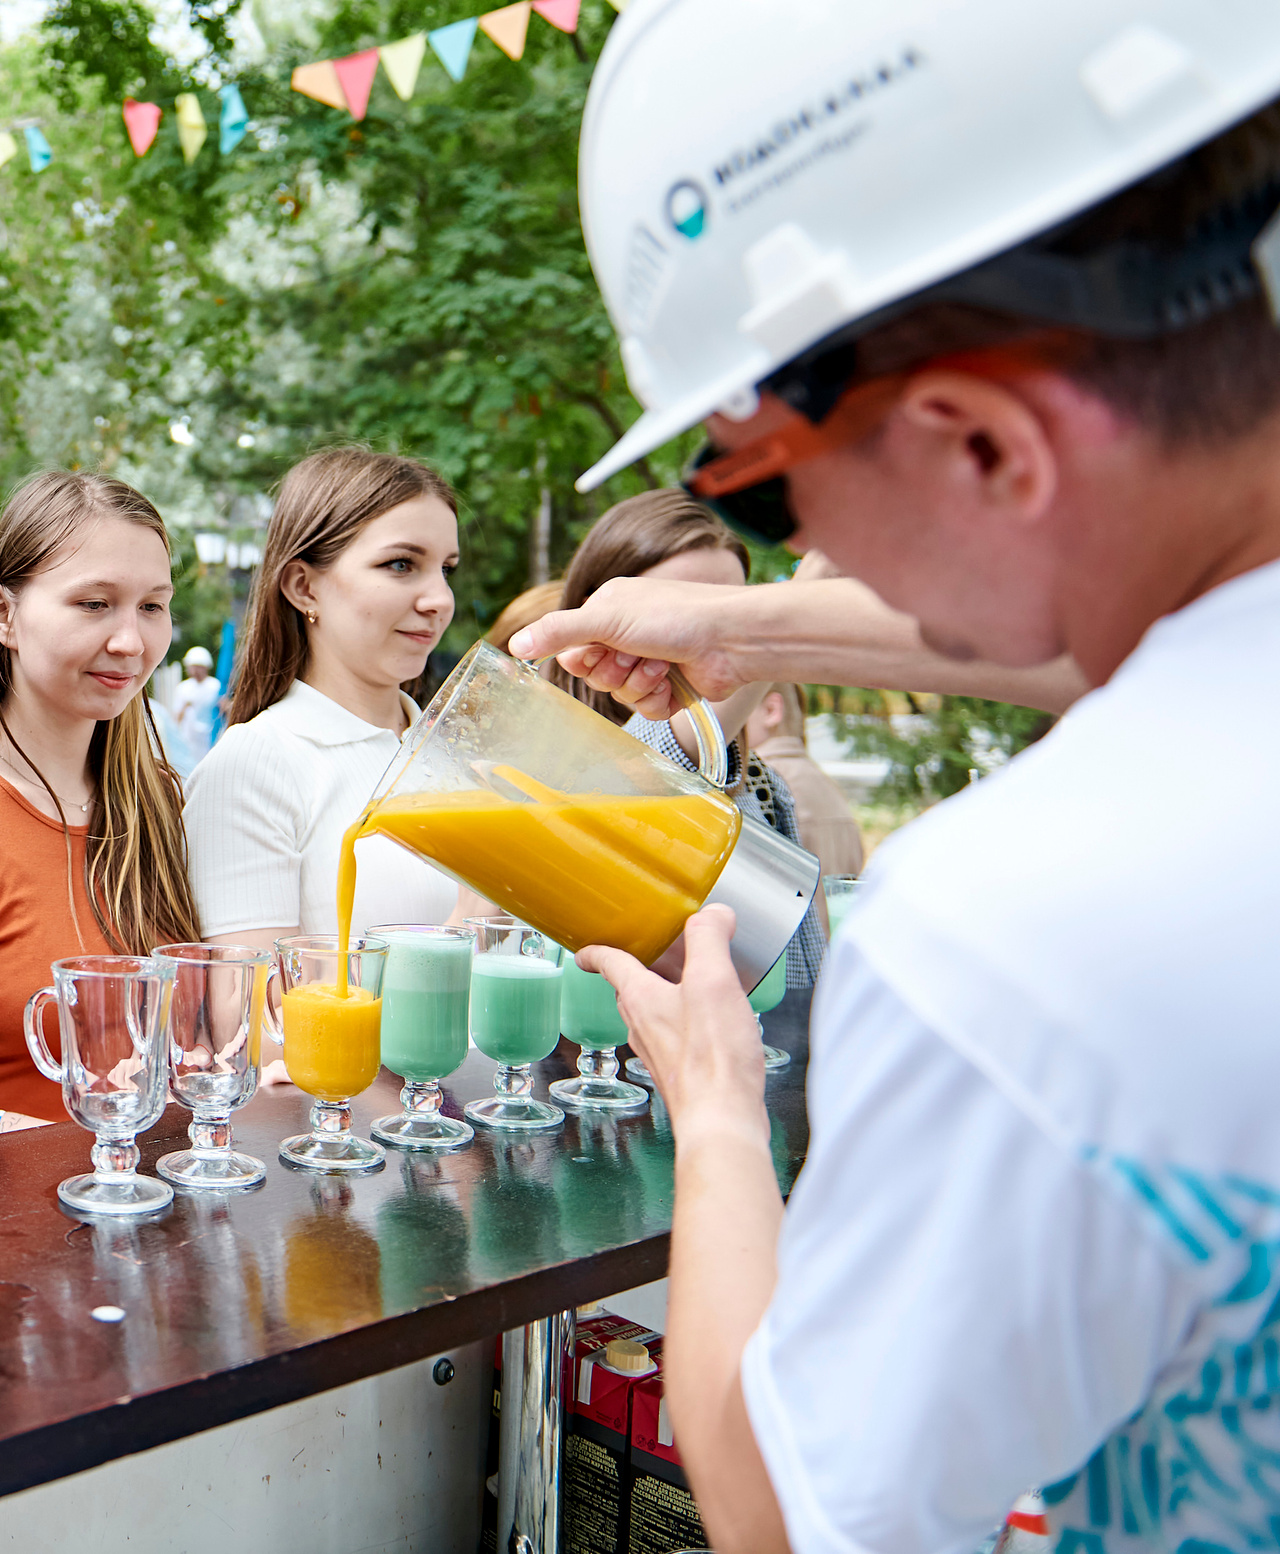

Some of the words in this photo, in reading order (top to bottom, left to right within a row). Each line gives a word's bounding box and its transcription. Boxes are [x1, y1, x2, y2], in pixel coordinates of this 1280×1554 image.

[646, 1475, 659, 1486] КРЕМ
[660, 1481, 691, 1499] СЛИВОЧНЫЙ
[633, 1486, 657, 1502] МАССОВАЯ
[672, 1505, 687, 1515] ЖИРА
